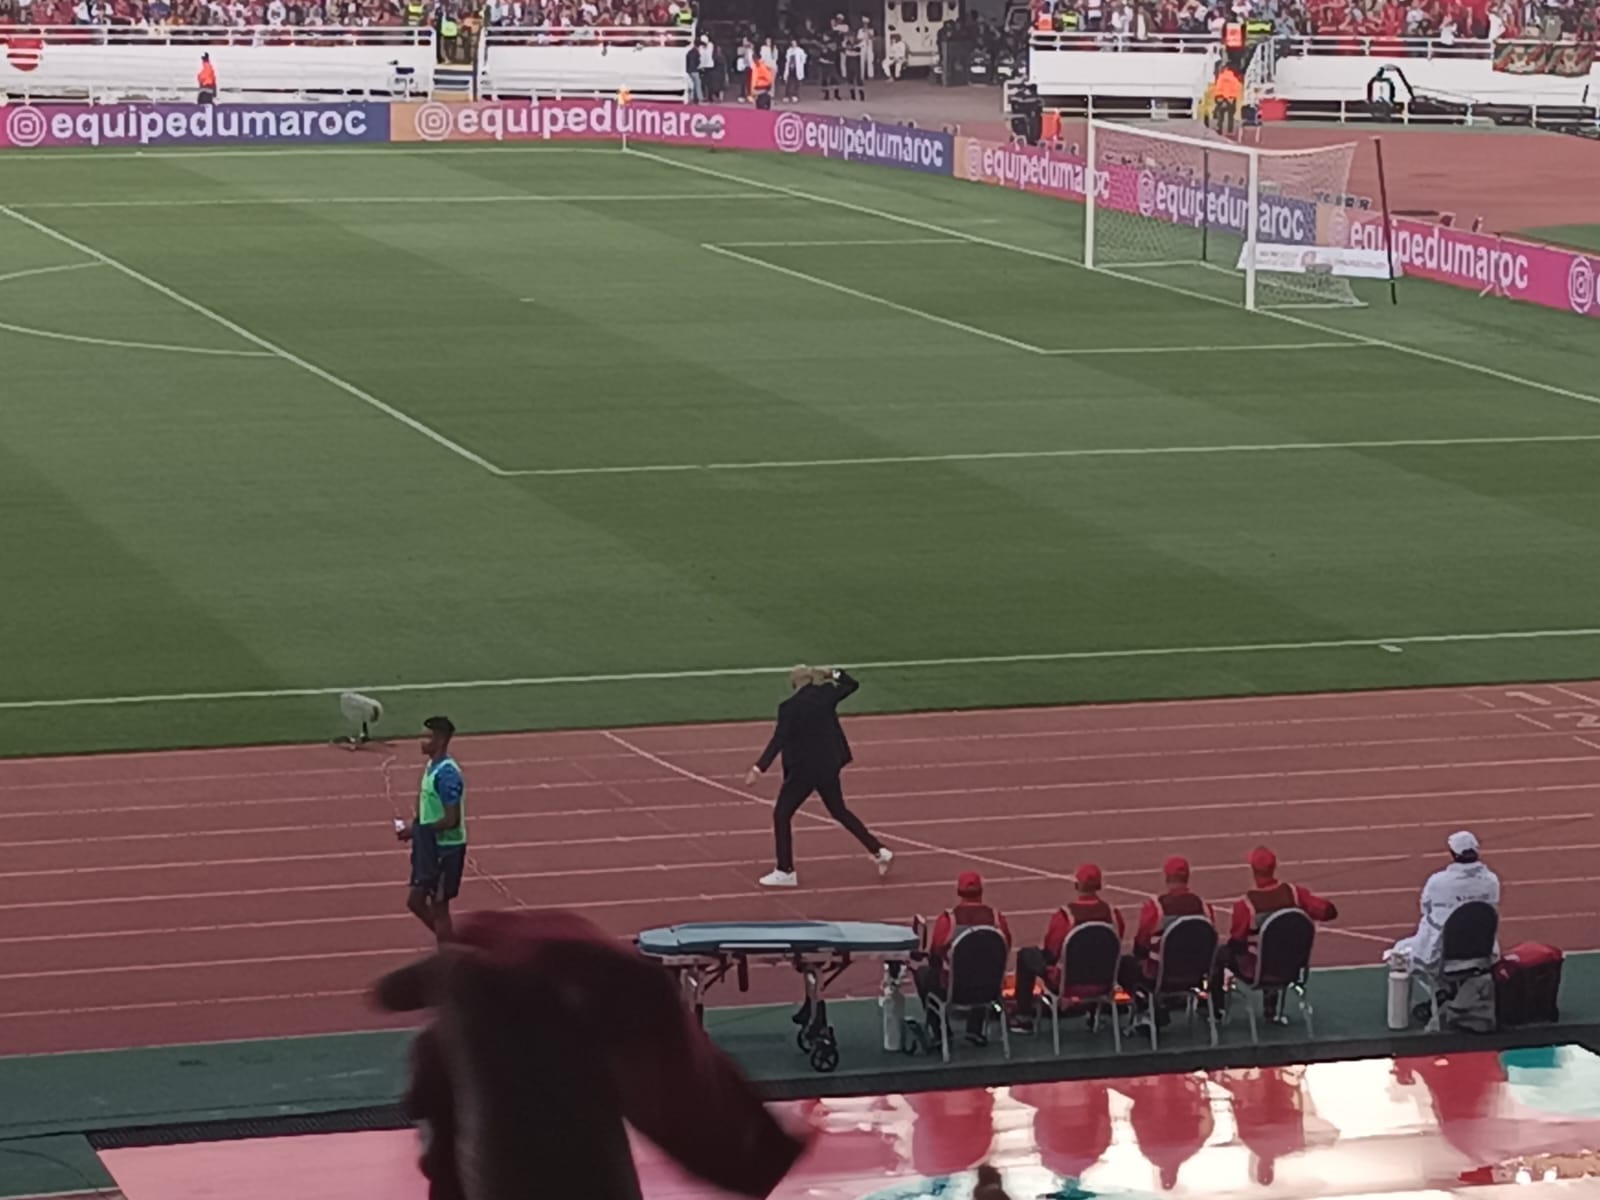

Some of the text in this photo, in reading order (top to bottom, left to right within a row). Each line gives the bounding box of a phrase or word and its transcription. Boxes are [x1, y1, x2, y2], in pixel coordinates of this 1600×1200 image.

[51, 105, 367, 145] equipedumaroc
[457, 100, 726, 140] equipedumaroc
[805, 118, 943, 167] equipedumaroc
